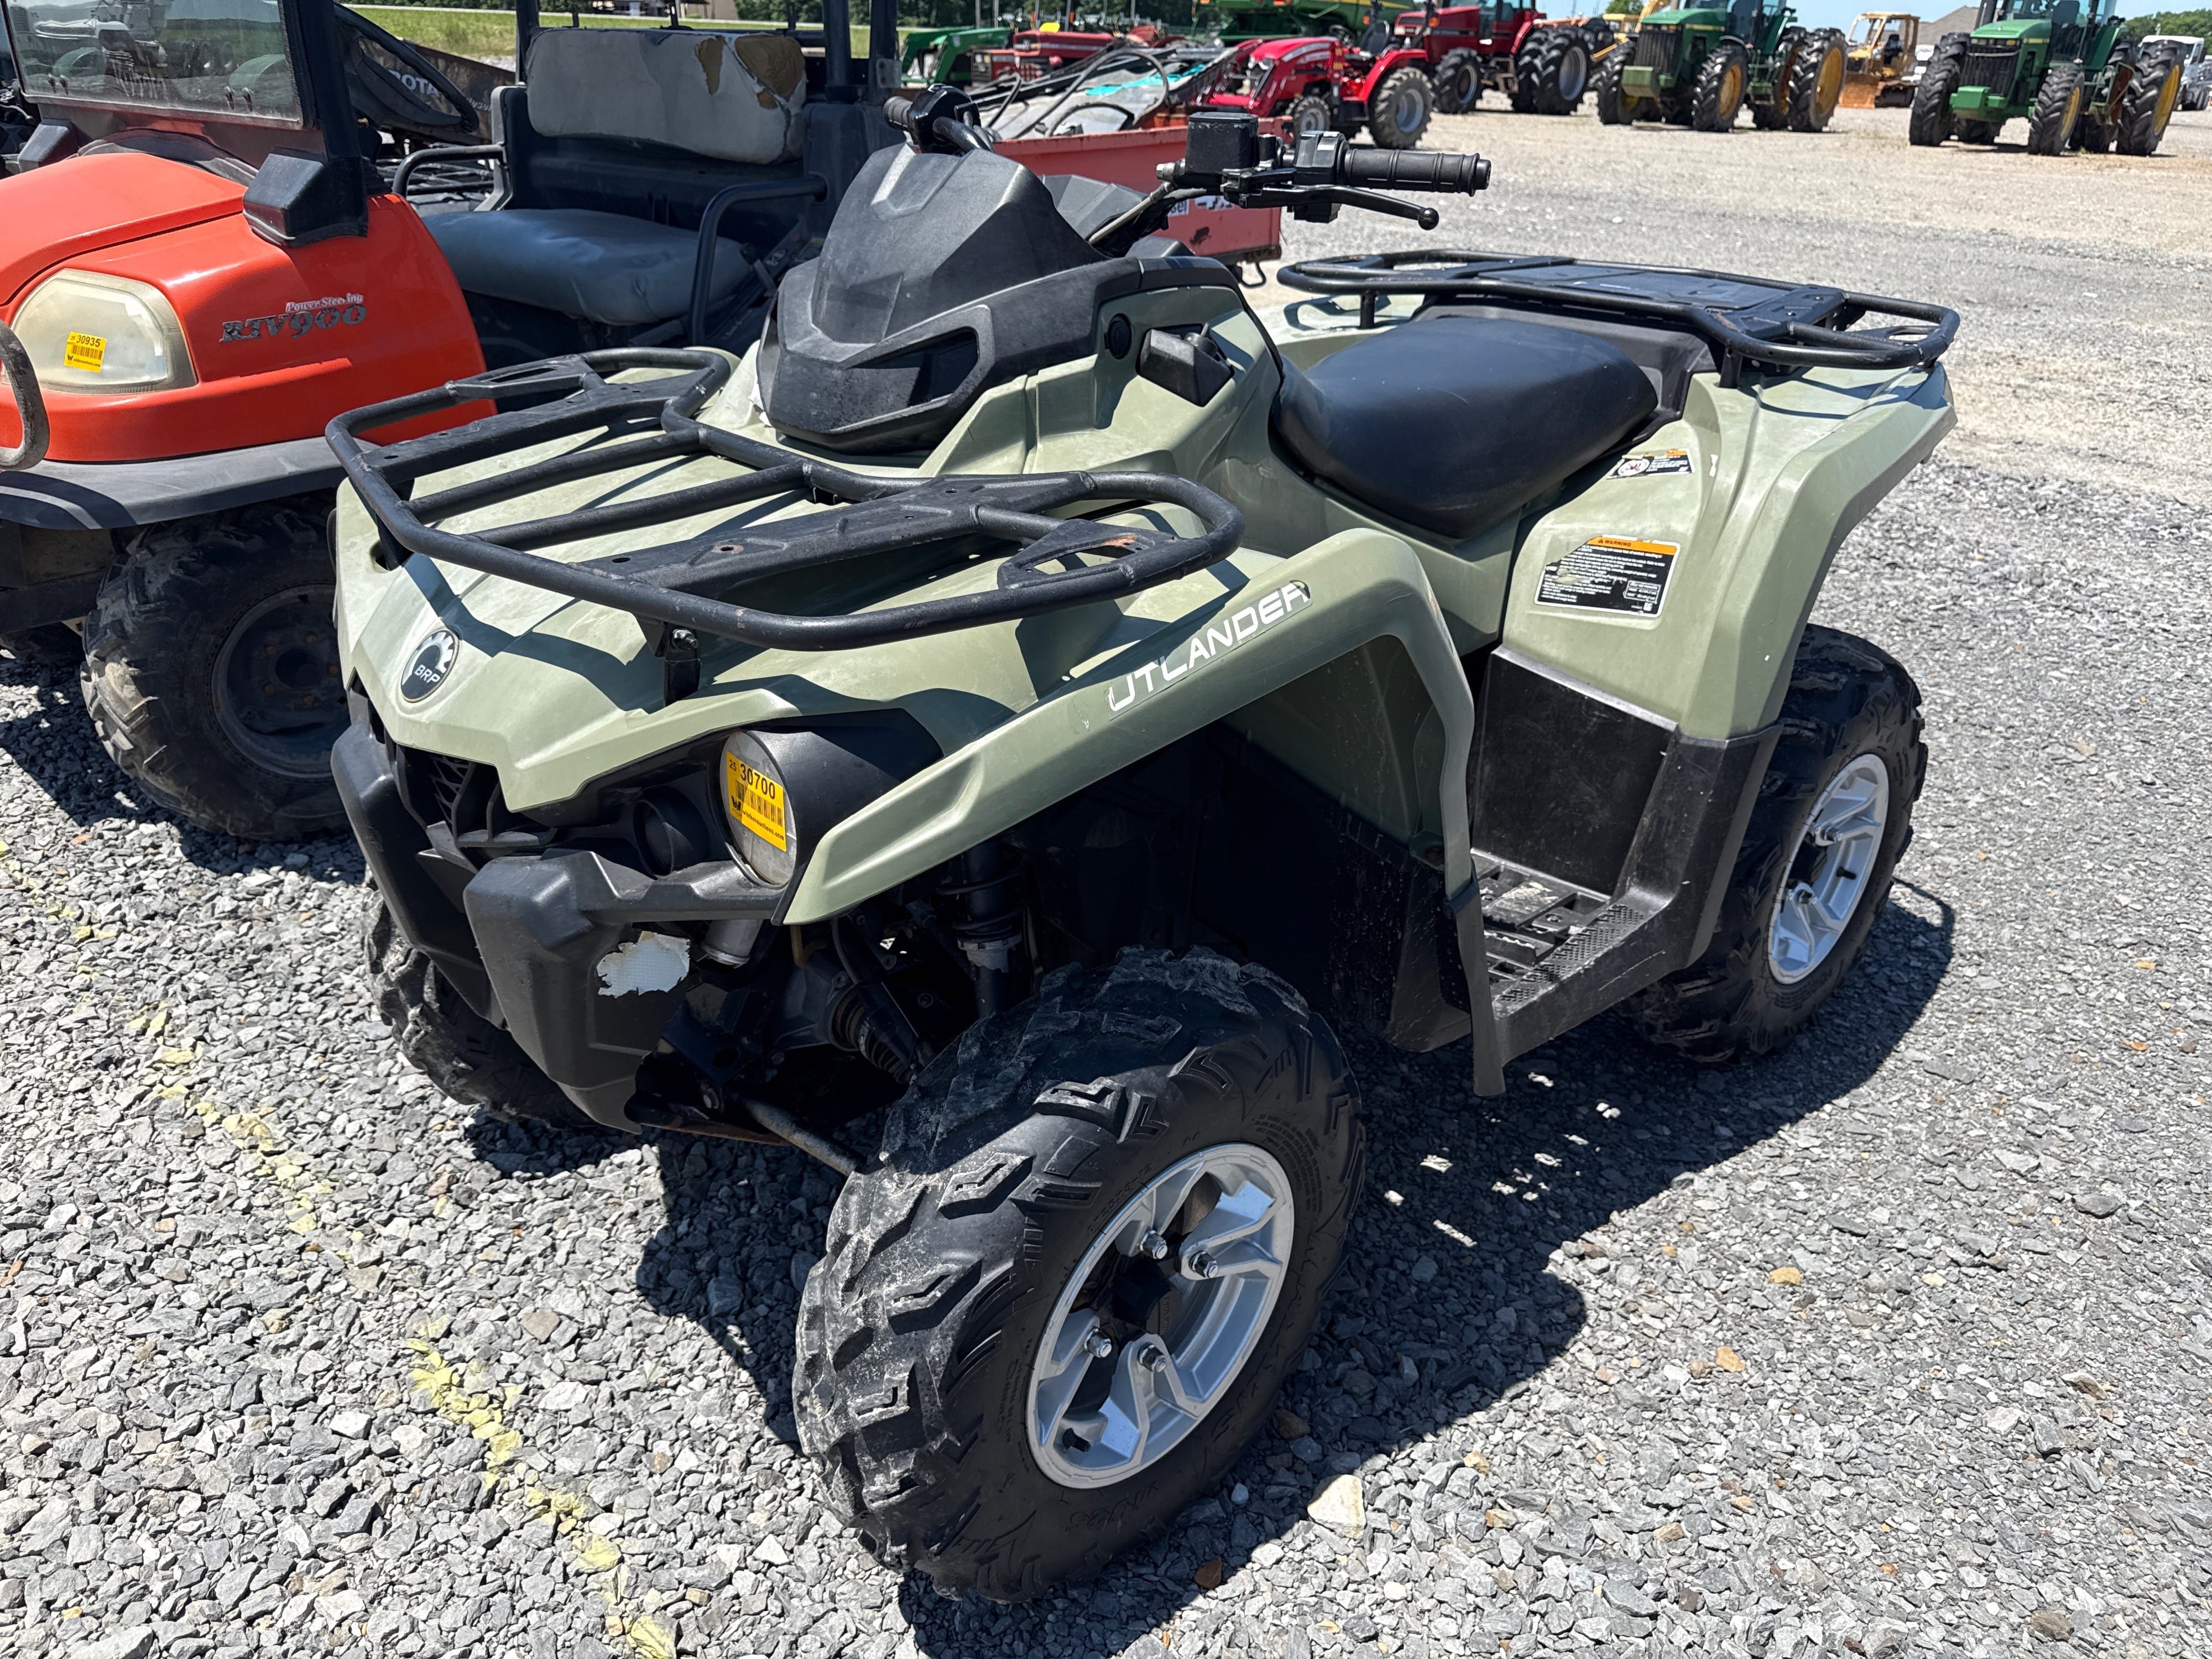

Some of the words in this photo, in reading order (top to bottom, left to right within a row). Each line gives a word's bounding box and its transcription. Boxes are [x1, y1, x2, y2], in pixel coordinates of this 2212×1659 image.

[286, 300, 319, 312] Power
[218, 304, 367, 343] RTV900
[76, 335, 101, 347] 30935
[414, 664, 441, 684] BRP
[729, 759, 737, 771] 25
[740, 763, 775, 800] 30700
